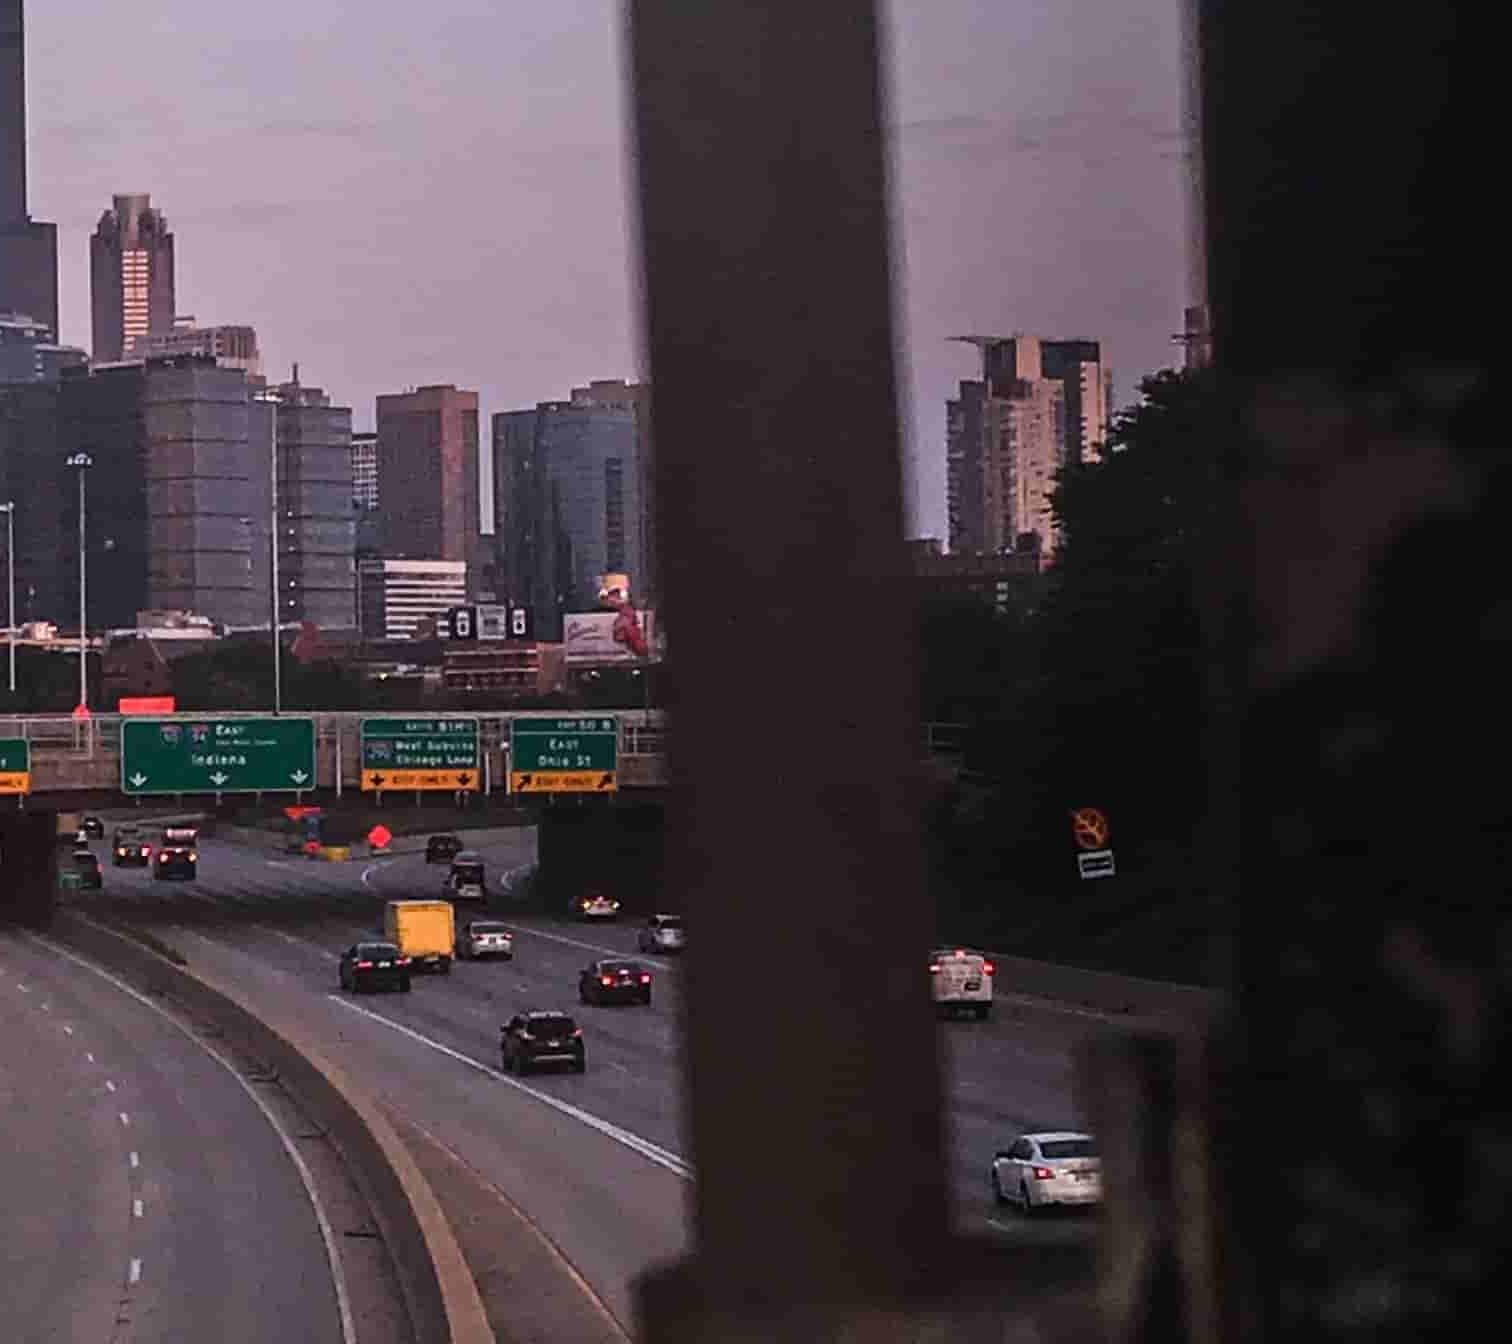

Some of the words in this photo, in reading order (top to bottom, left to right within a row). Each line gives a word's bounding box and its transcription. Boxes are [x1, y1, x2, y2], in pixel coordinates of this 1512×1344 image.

[549, 737, 579, 751] EAST
[191, 754, 247, 767] Indiana
[537, 755, 570, 767] Ohio
[576, 755, 592, 767] St
